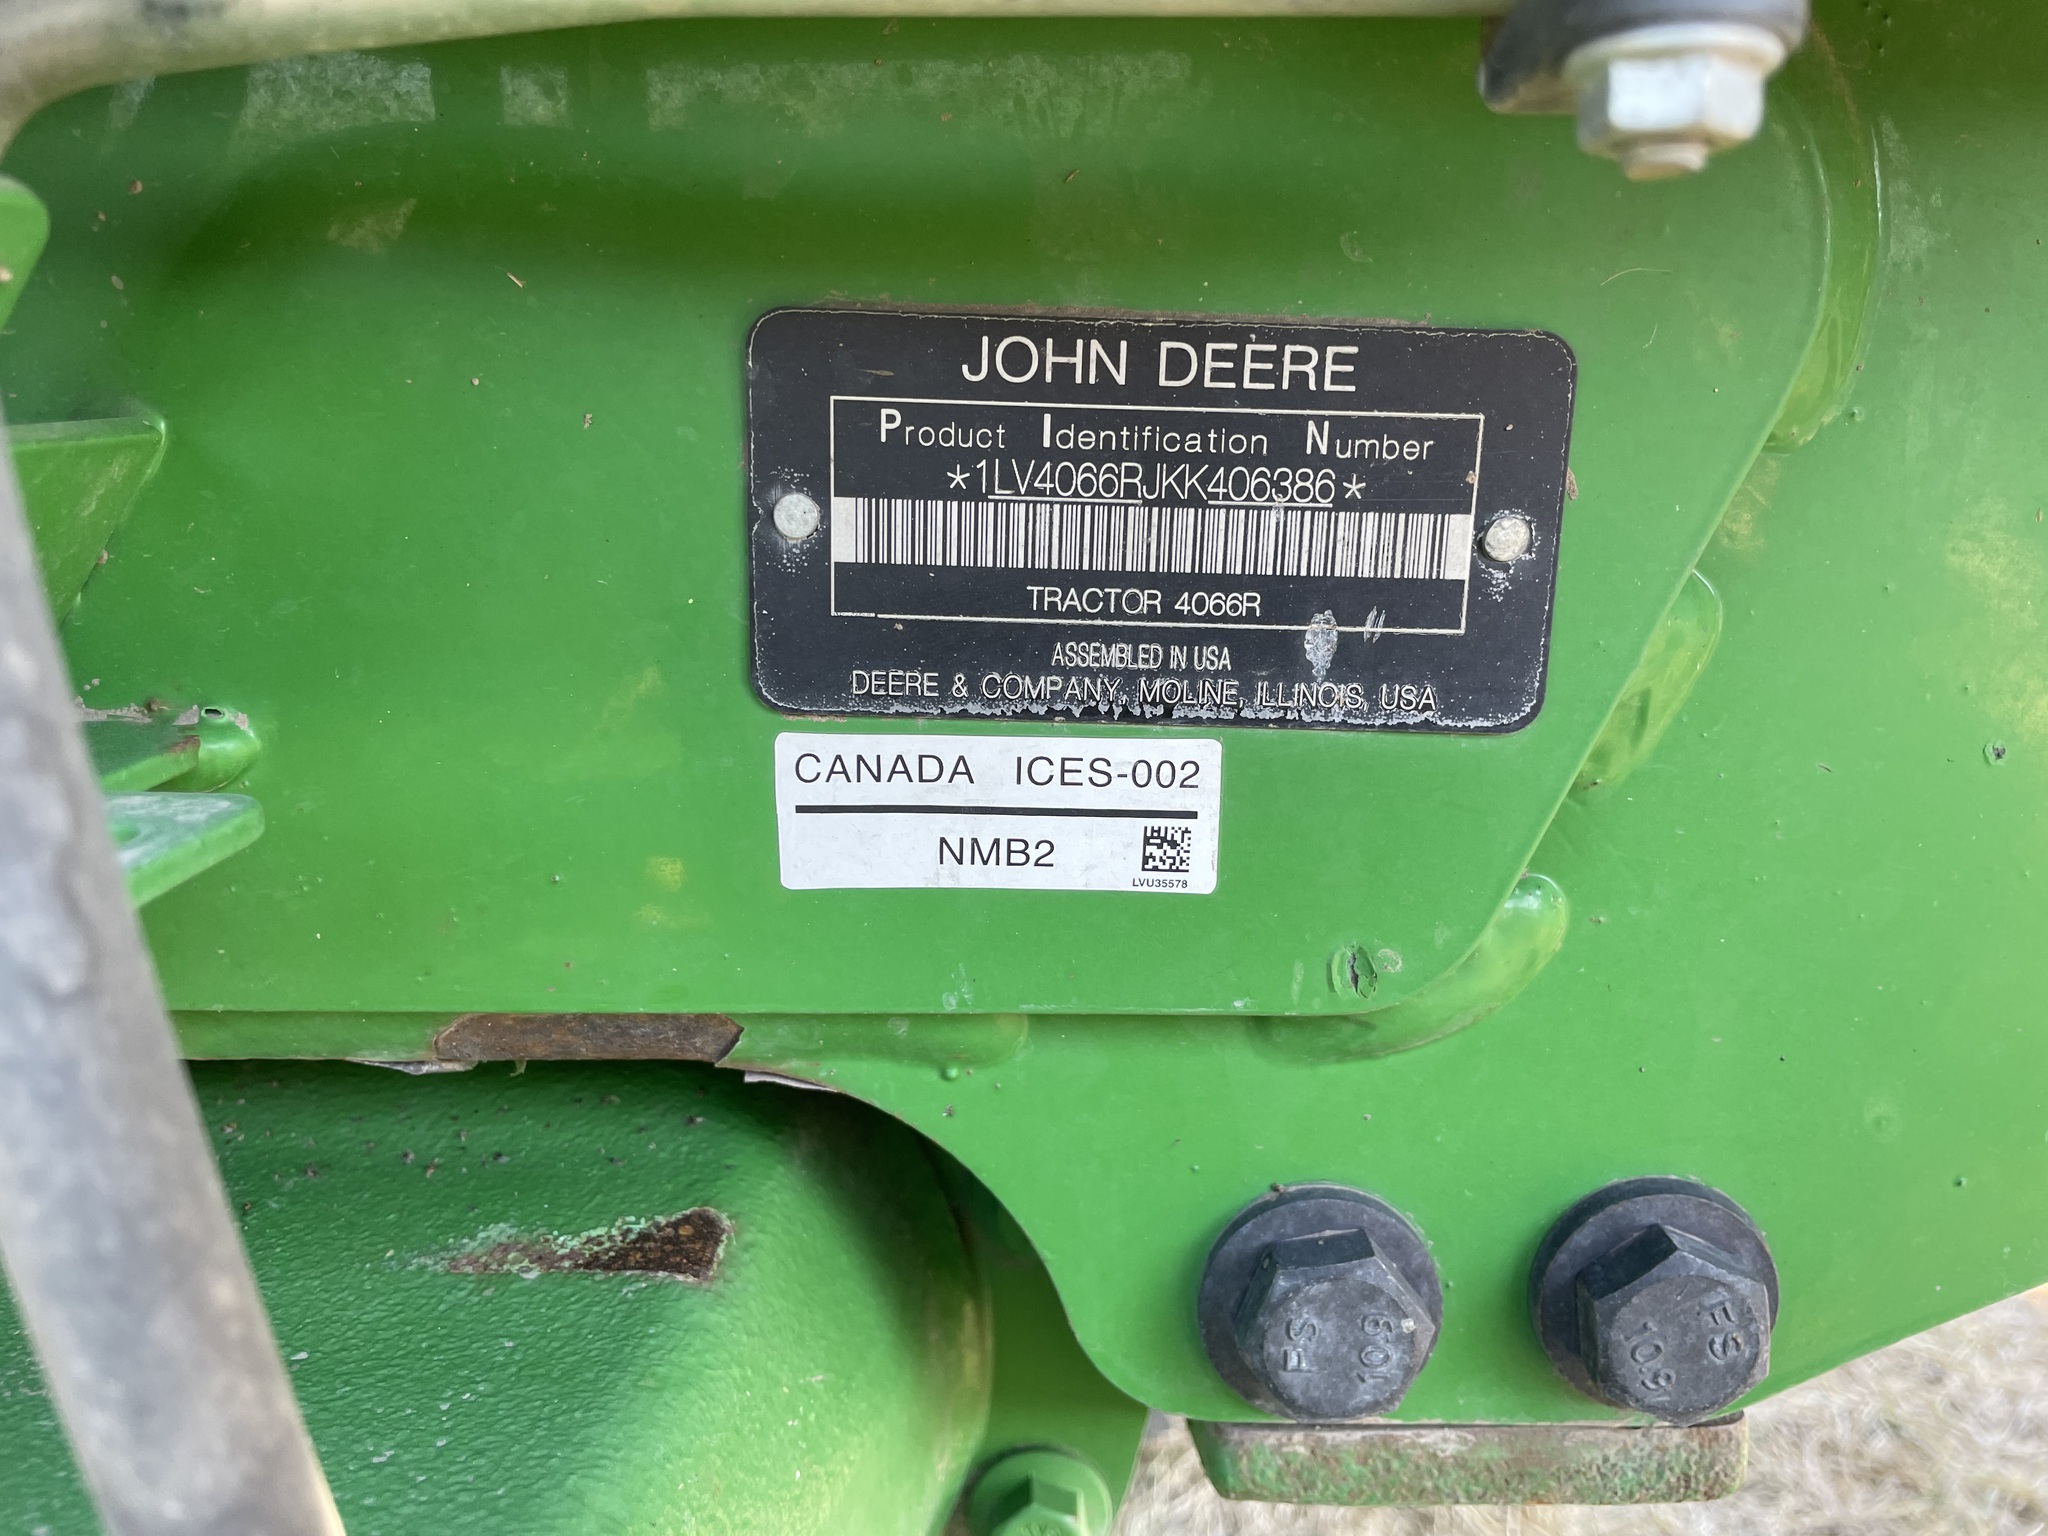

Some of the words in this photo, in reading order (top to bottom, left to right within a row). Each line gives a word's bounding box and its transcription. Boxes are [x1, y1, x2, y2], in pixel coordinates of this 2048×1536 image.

[961, 335, 1128, 386] JOHN
[1158, 341, 1359, 393] DEERE
[880, 408, 1006, 449] Product
[1042, 413, 1268, 456] Identification
[1305, 420, 1435, 461] Number
[1027, 586, 1163, 616] TRACTOR
[1174, 592, 1262, 618] 4066R
[1051, 642, 1163, 670] ASSEMBLED
[1169, 645, 1188, 670] IN
[1193, 645, 1232, 672] USA
[851, 670, 940, 698] DEERE
[952, 674, 970, 699] &
[1139, 679, 1244, 708] MOLINE,
[1257, 682, 1368, 712] ILLINOIS,
[1379, 684, 1438, 713] USA
[794, 752, 976, 784] CANADA
[1015, 756, 1200, 790] ICES-002
[938, 836, 1055, 868] NMB2
[1132, 877, 1188, 889] LVU35578
